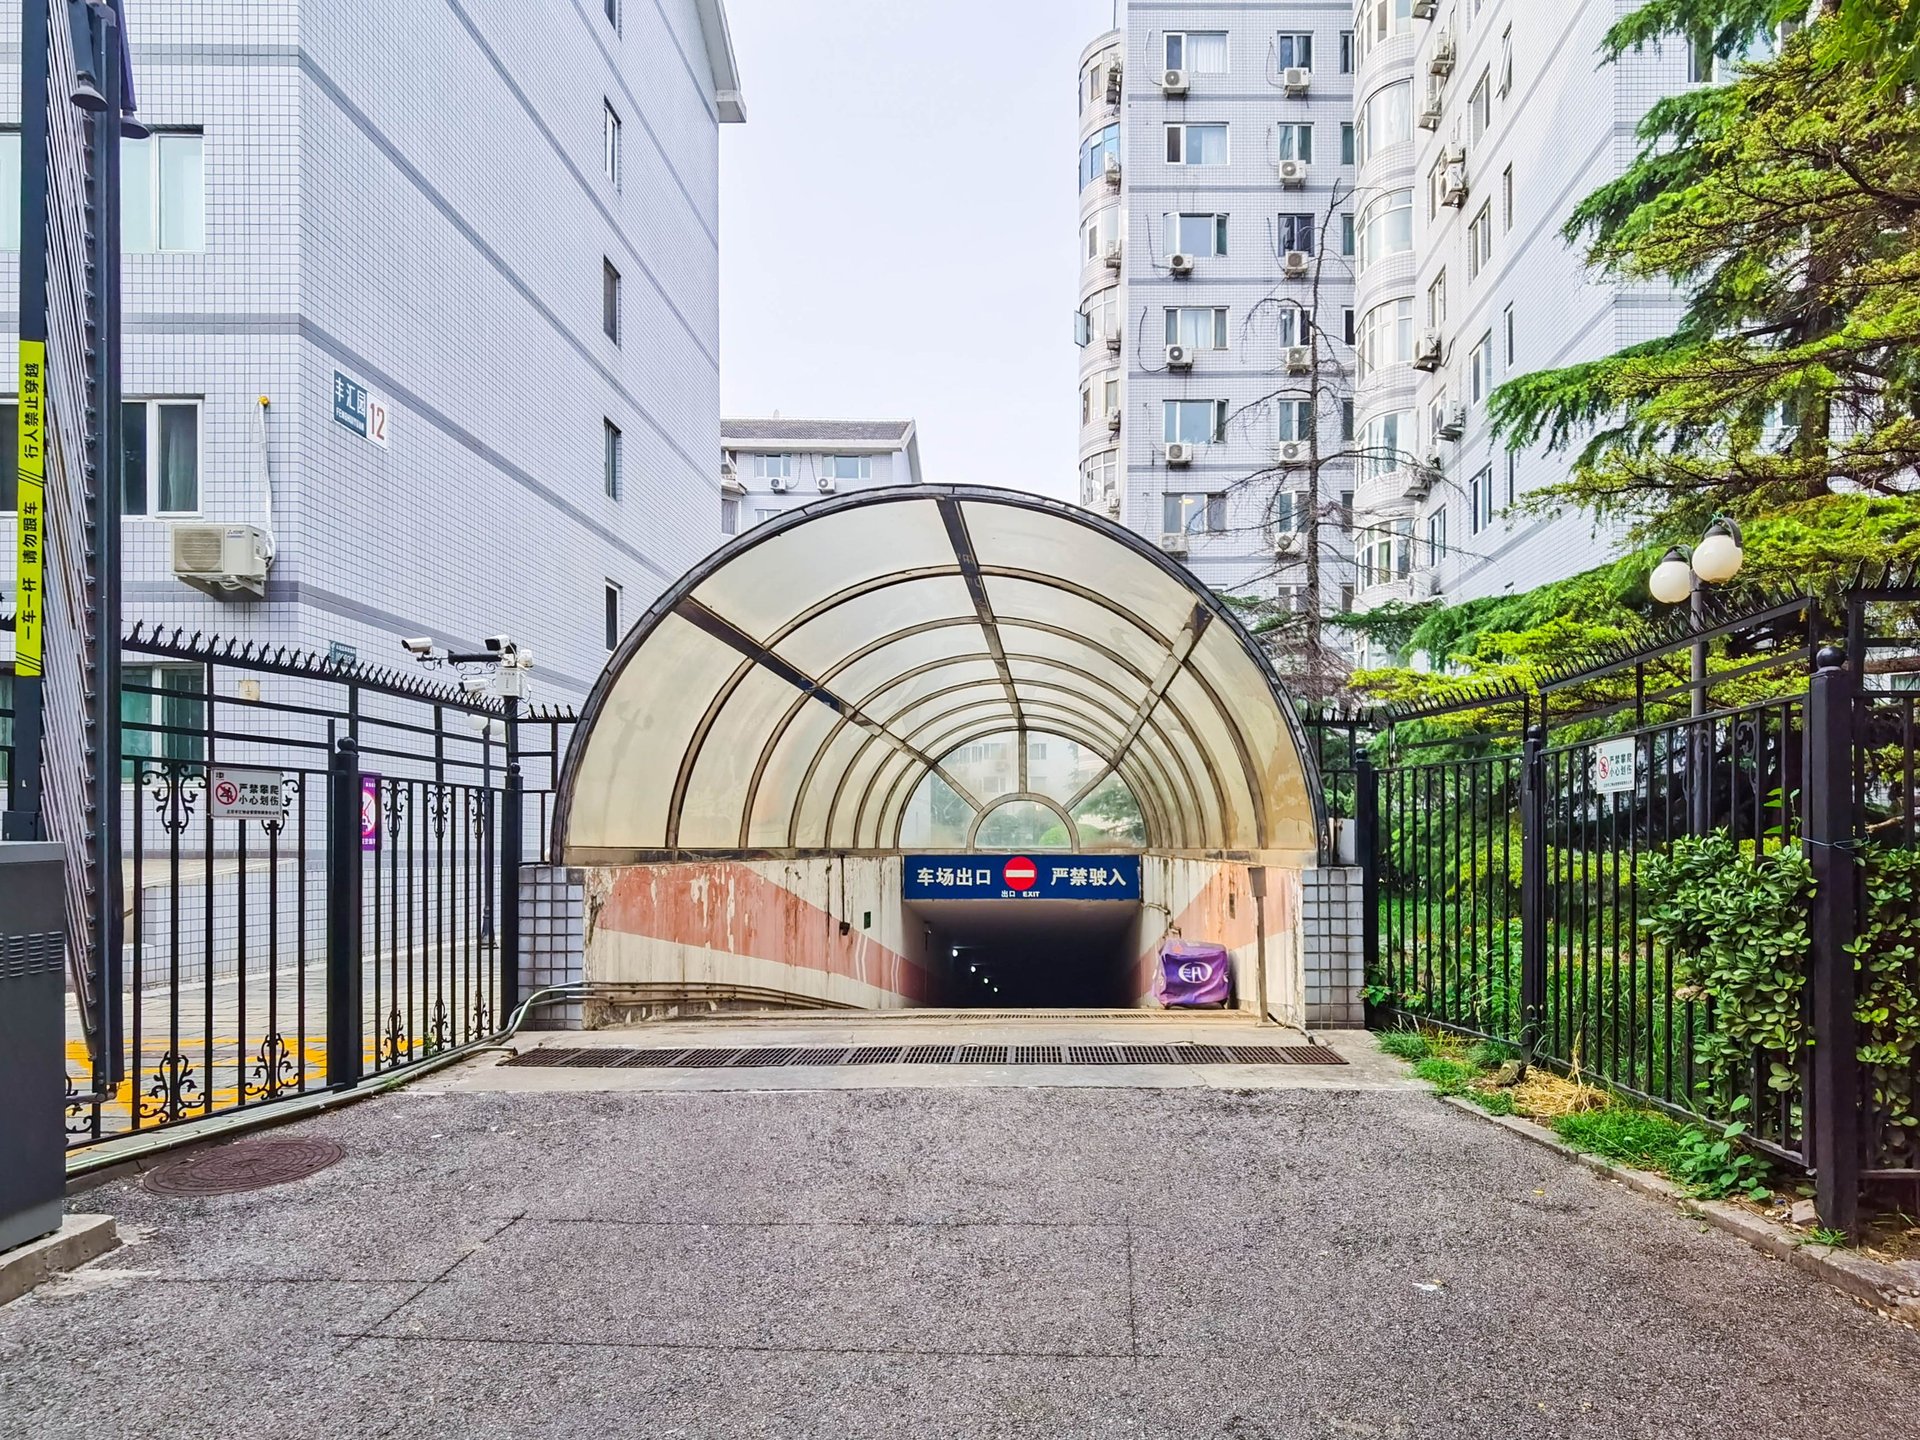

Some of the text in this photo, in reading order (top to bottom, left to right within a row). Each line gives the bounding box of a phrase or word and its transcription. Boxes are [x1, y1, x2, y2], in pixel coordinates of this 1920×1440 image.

[335, 377, 367, 418] 丰汇园
[24, 363, 39, 459] 行人禁止穿越
[370, 403, 385, 440] 12
[21, 501, 38, 640] 一车一杆 请勿跟车
[239, 783, 280, 796] 严禁攀爬
[238, 795, 279, 806] 小心划伤
[917, 867, 991, 887] 车场出口
[1050, 867, 1127, 886] 严禁驶入
[1001, 890, 1041, 898] 出口 EXIT
